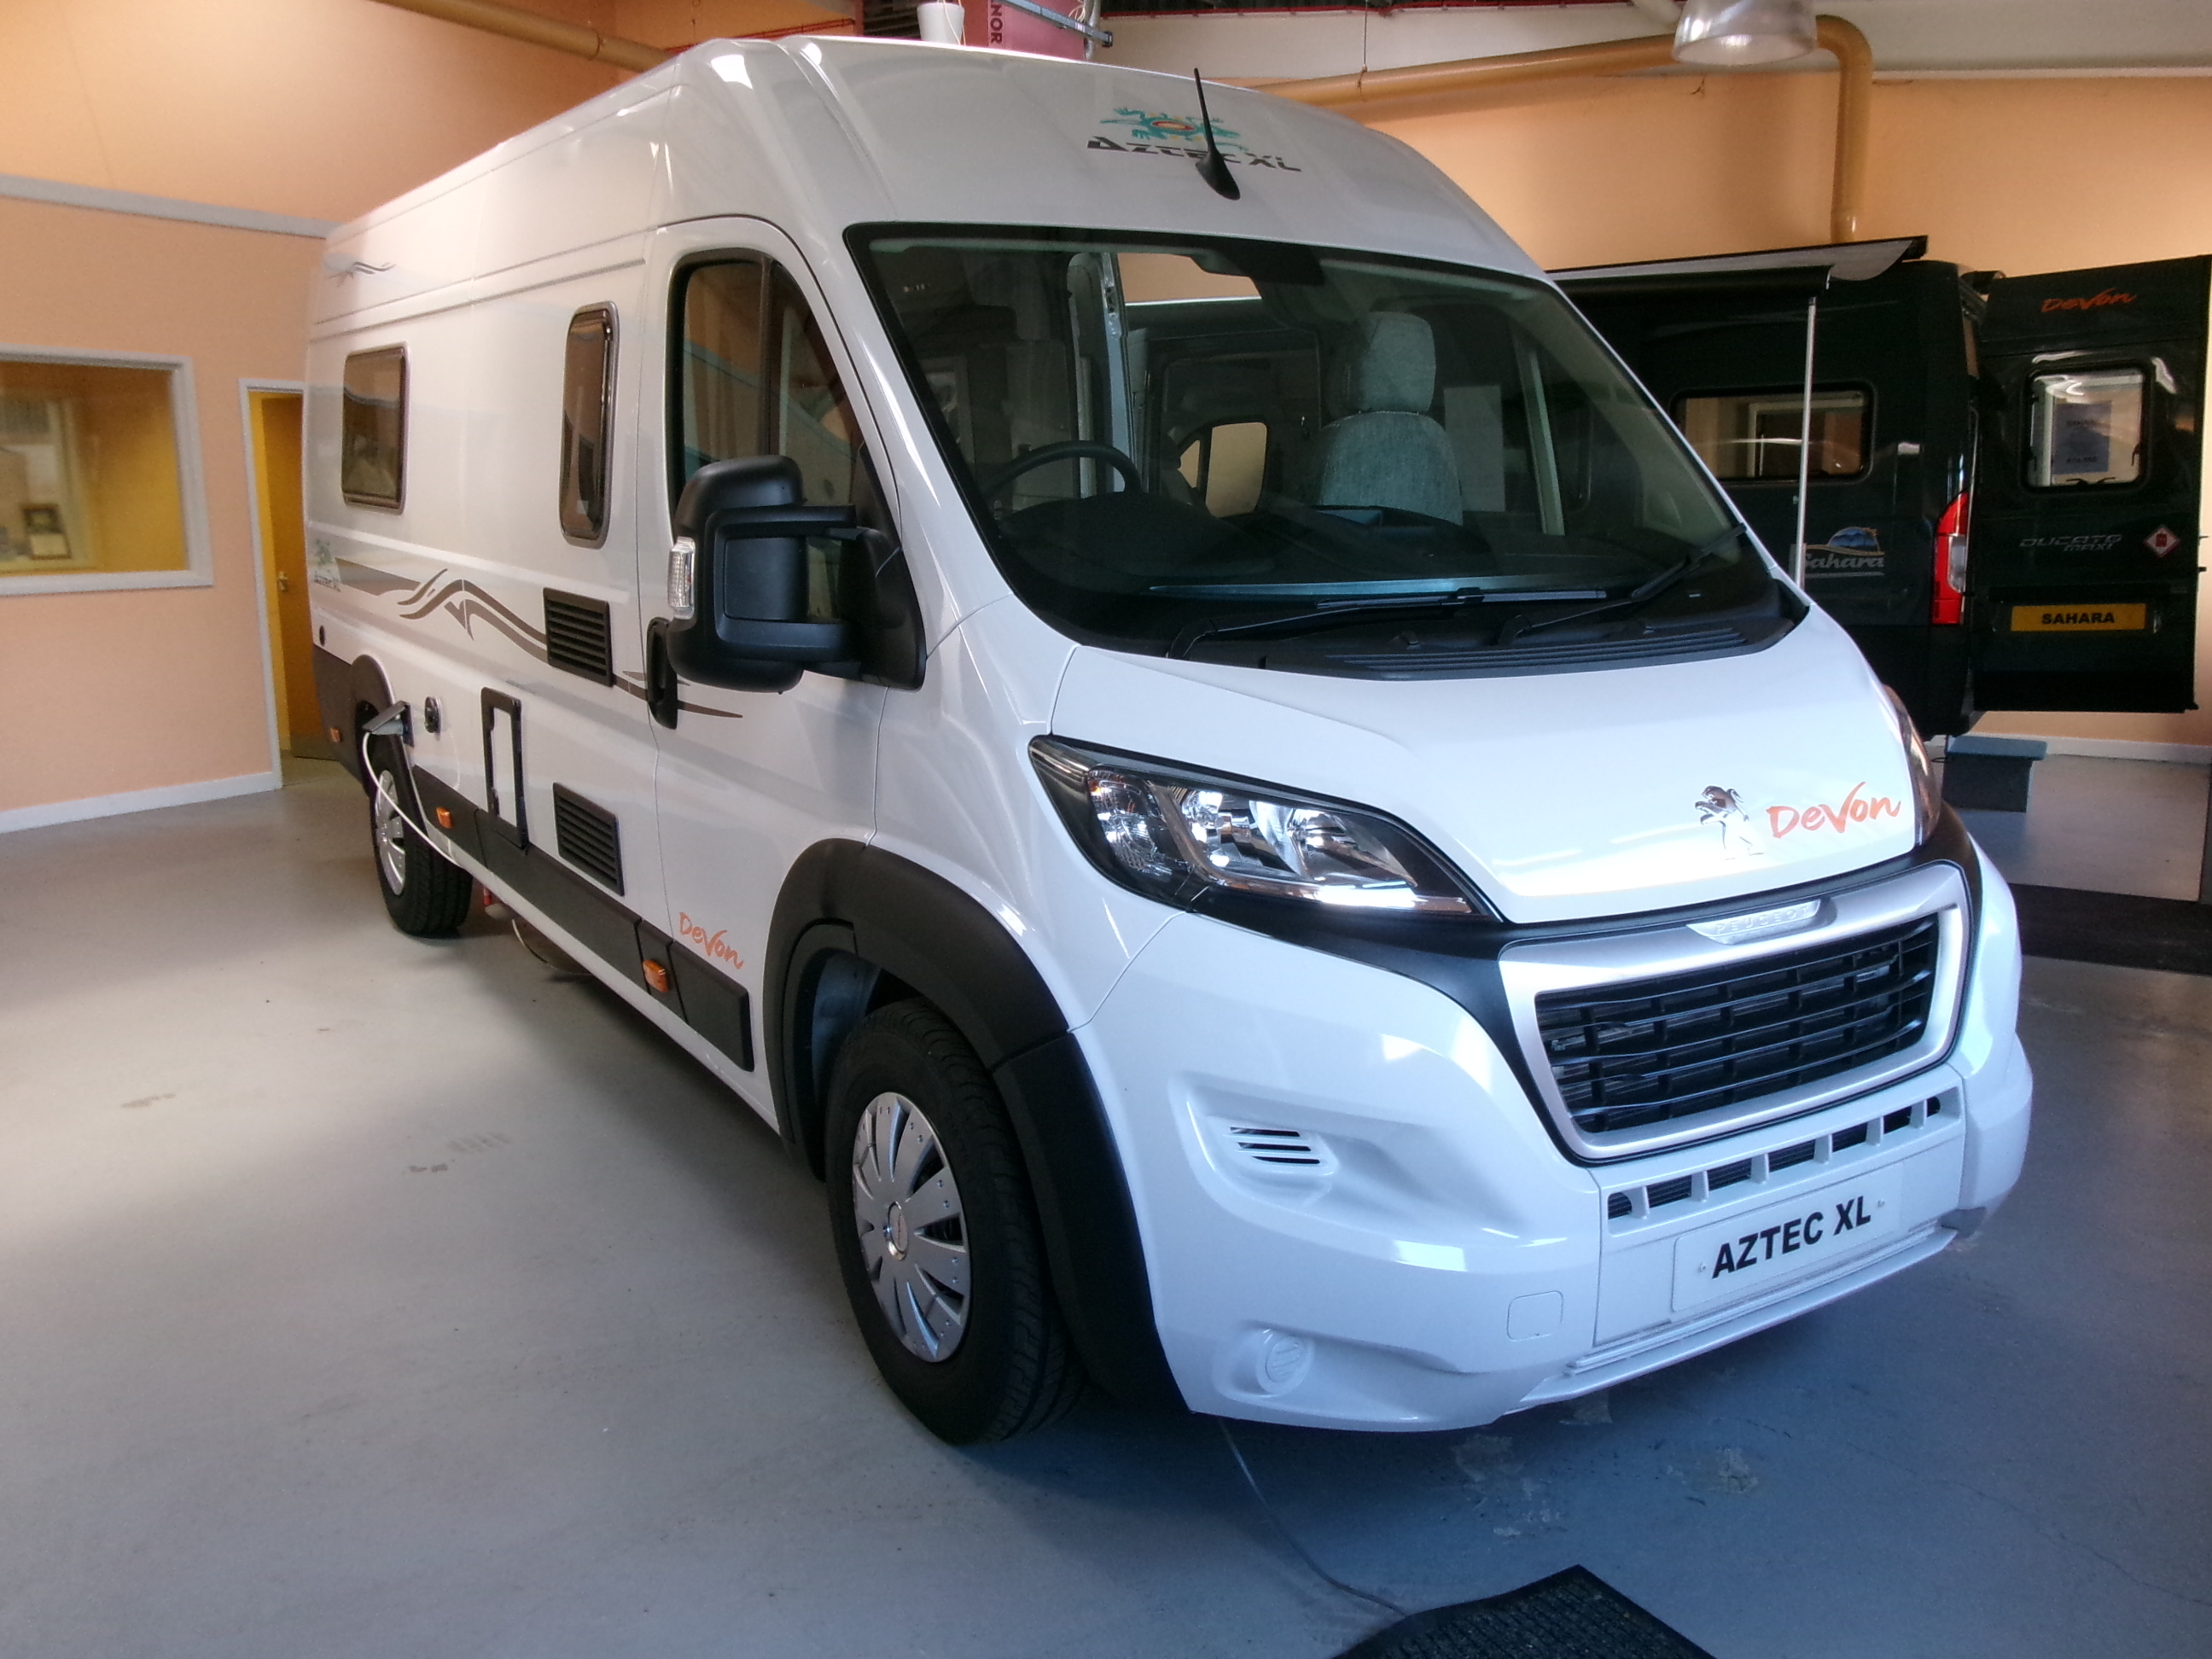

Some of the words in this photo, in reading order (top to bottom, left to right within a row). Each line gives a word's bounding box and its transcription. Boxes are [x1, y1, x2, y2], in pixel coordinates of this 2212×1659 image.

[990, 0, 1004, 44] NOR
[2018, 533, 2122, 547] DUCATO
[2041, 612, 2116, 625] SAHARA
[1715, 905, 1810, 934] PEUGEOT
[1711, 1211, 1824, 1279] AZTEC
[1833, 1195, 1871, 1237] XL
